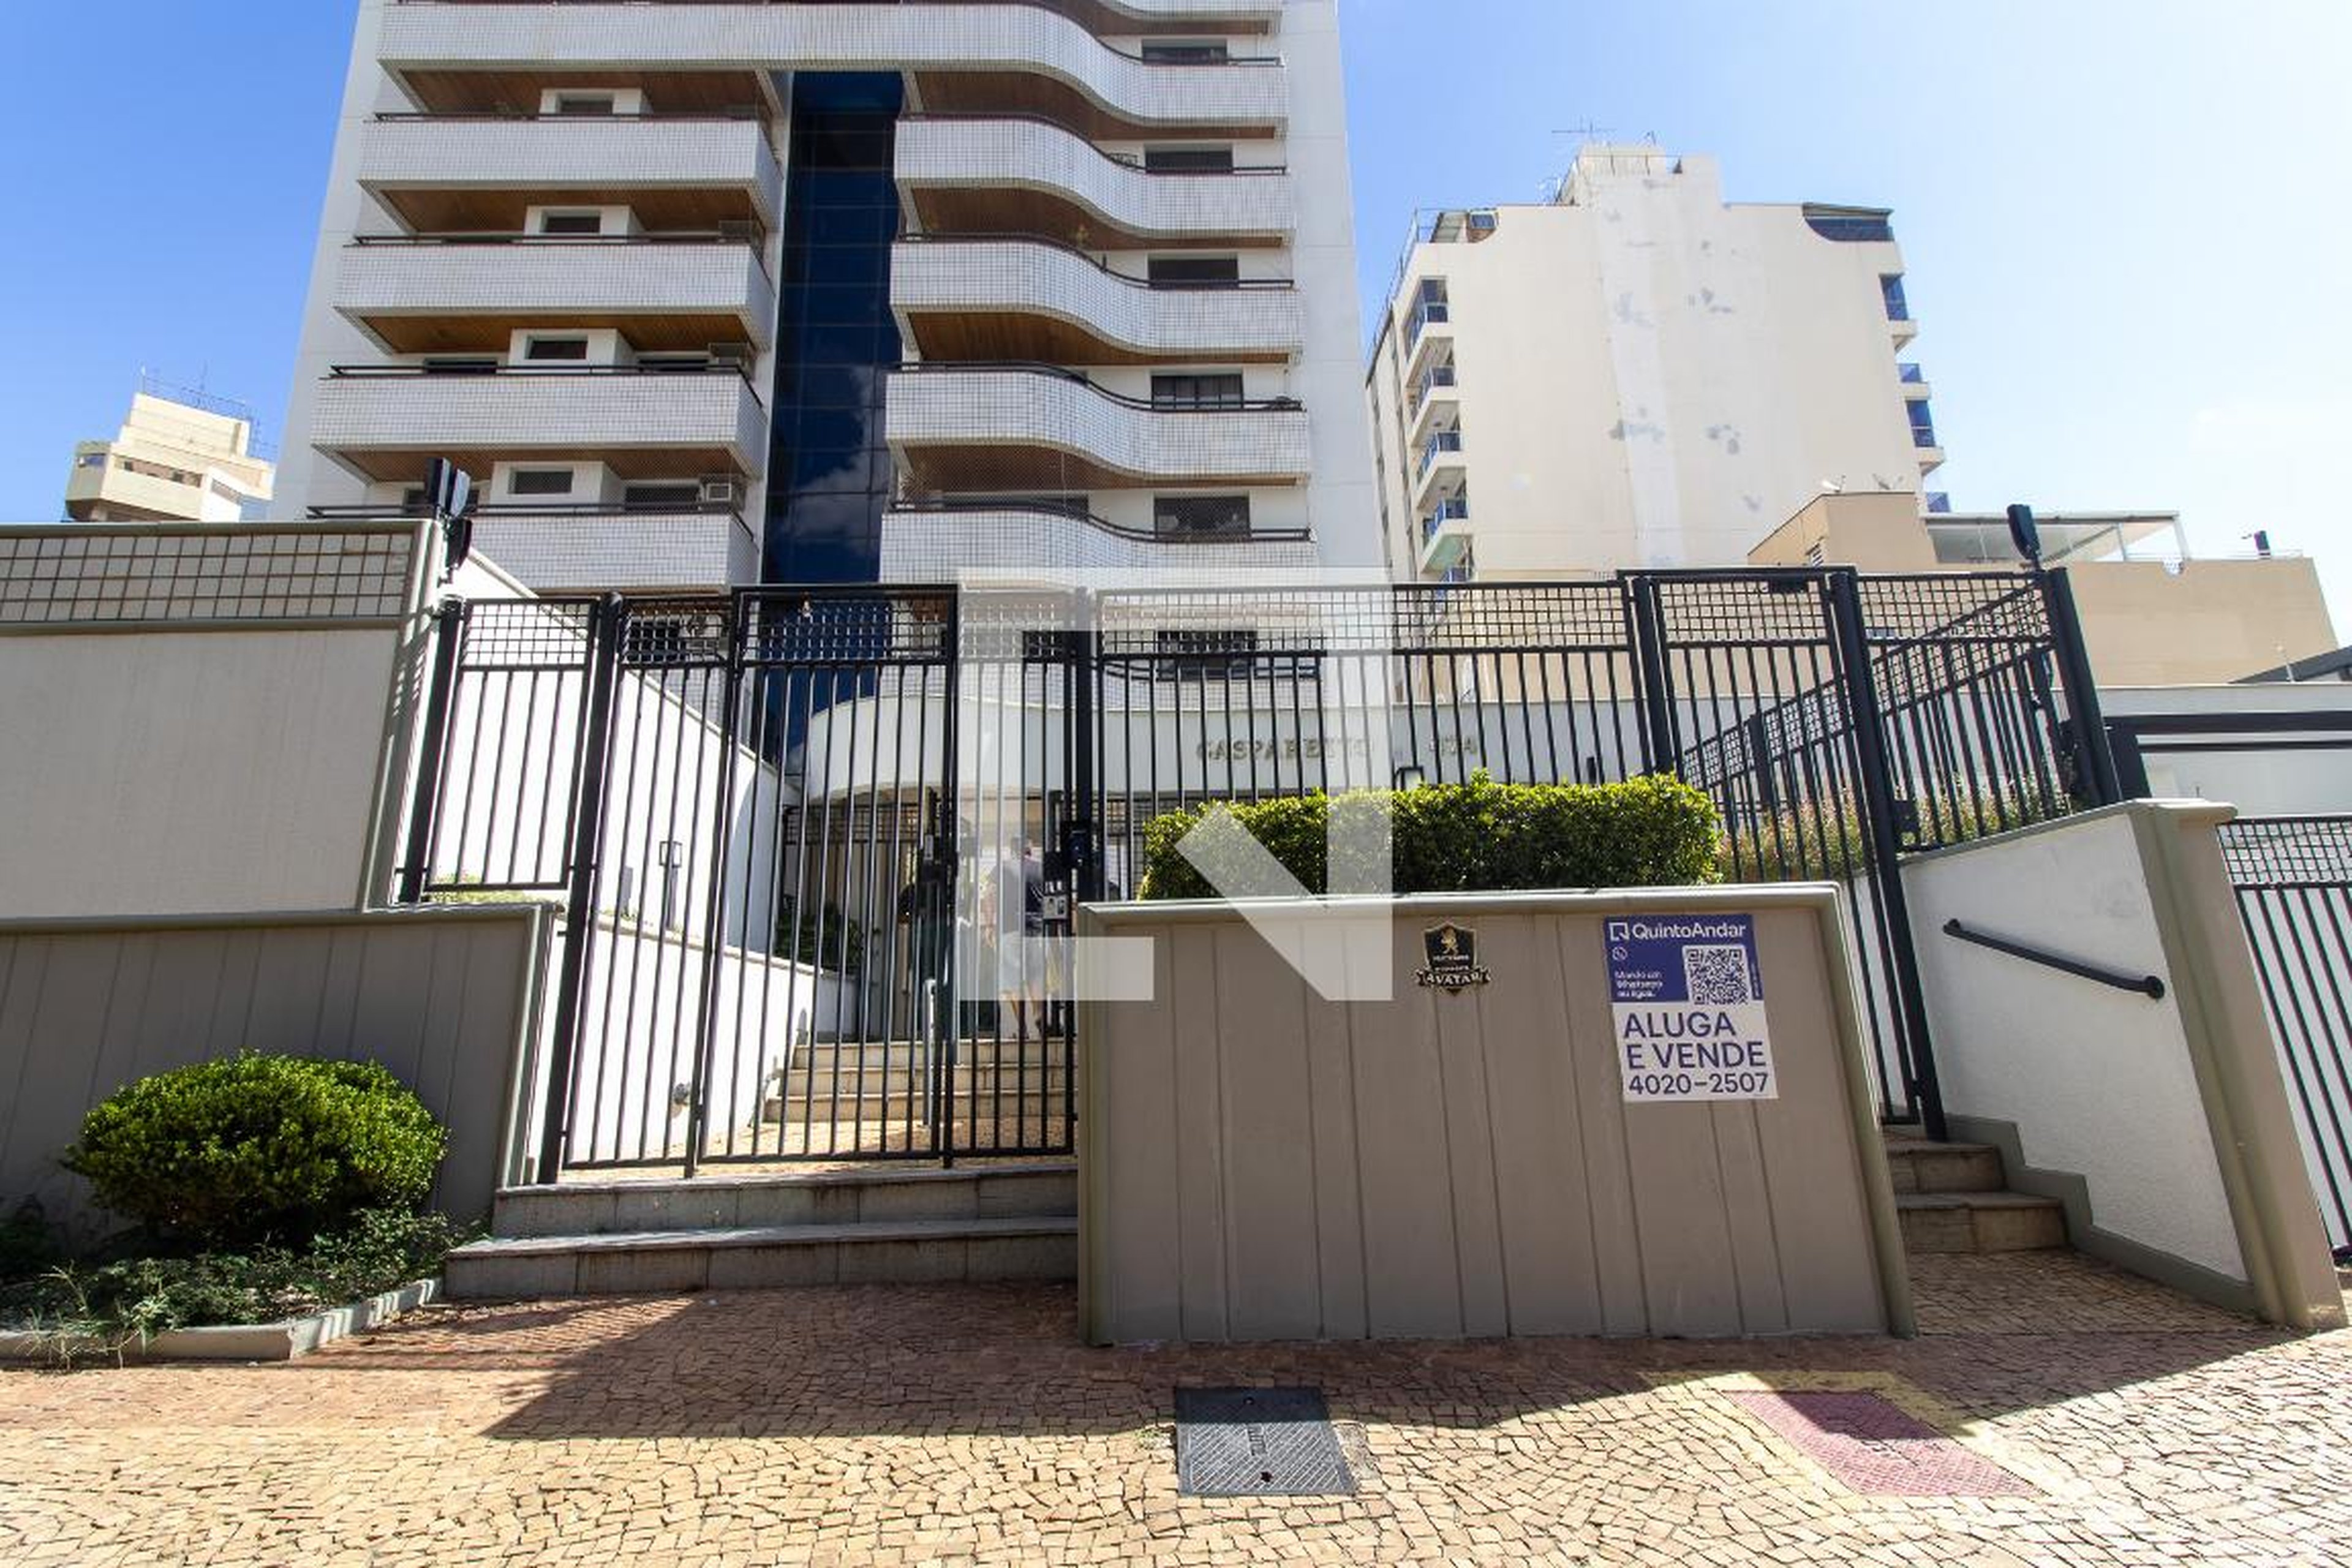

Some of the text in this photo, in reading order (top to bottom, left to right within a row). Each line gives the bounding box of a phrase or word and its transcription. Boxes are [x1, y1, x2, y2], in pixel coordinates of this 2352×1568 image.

[1632, 922, 1746, 940] QuintoAndar
[1624, 1012, 1736, 1038] ALUGA
[1626, 1041, 1767, 1069] E VENDE
[1629, 1072, 1768, 1095] 4020-2507
